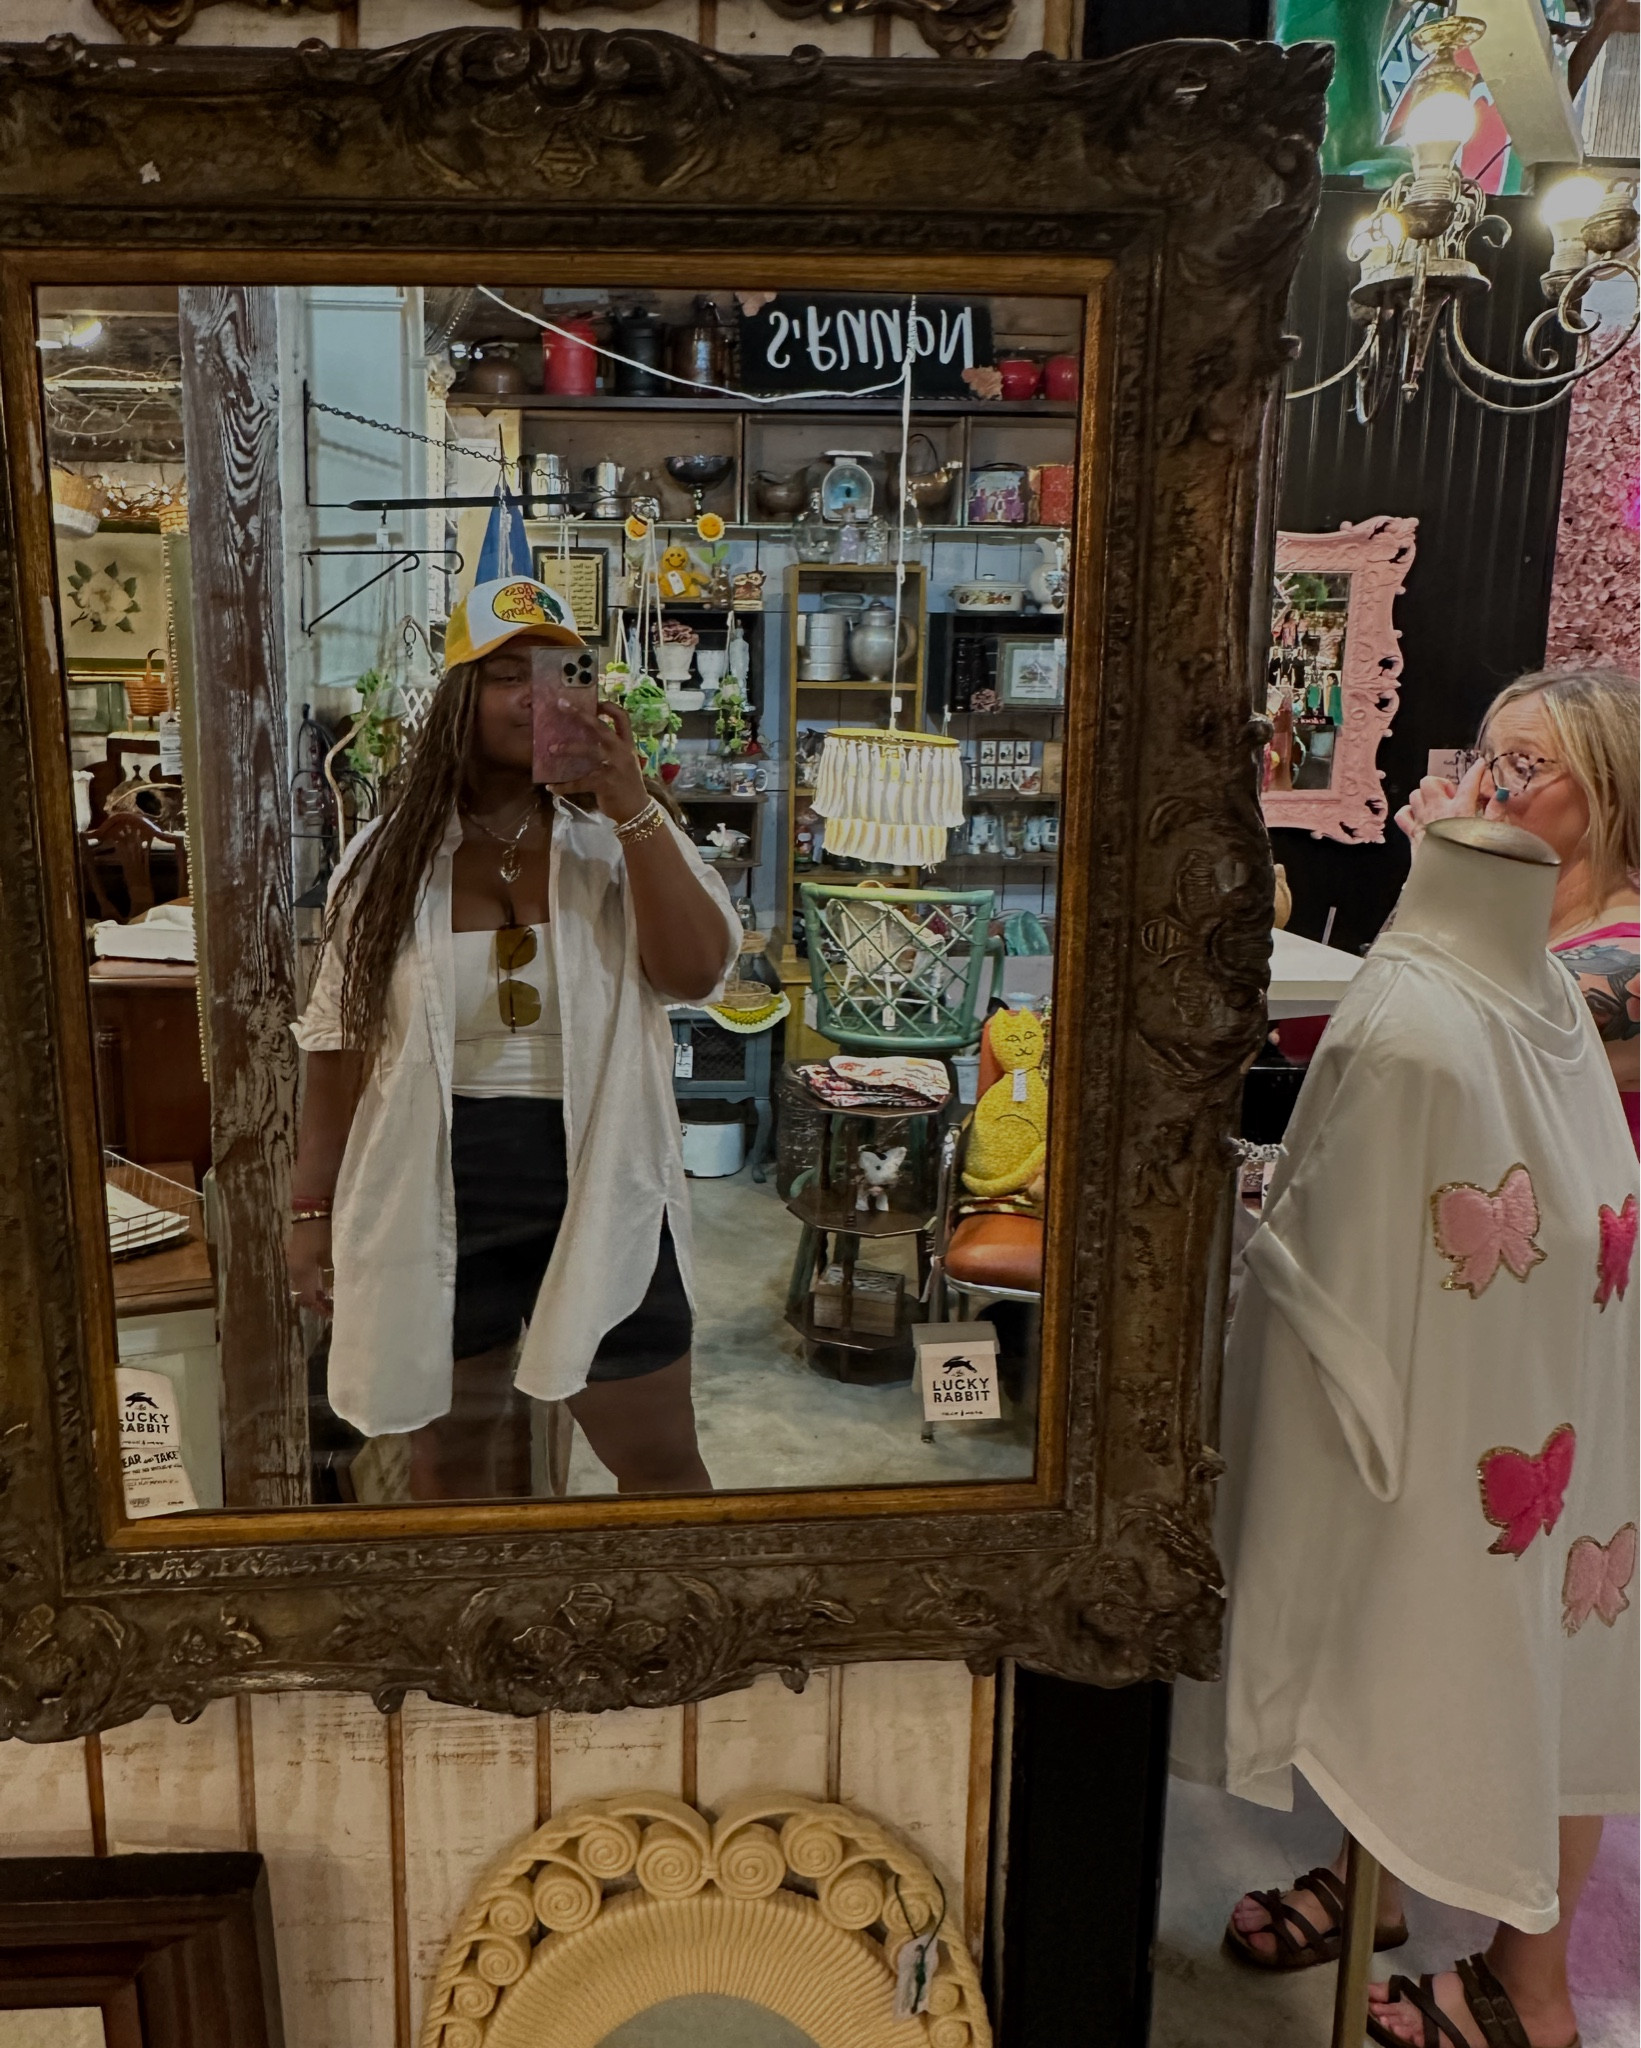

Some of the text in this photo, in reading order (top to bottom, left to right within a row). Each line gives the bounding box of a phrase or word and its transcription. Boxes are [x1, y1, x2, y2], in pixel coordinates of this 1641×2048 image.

[932, 1377, 990, 1391] LUCKY
[933, 1390, 990, 1403] RABBIT
[154, 1450, 179, 1464] TAKE
